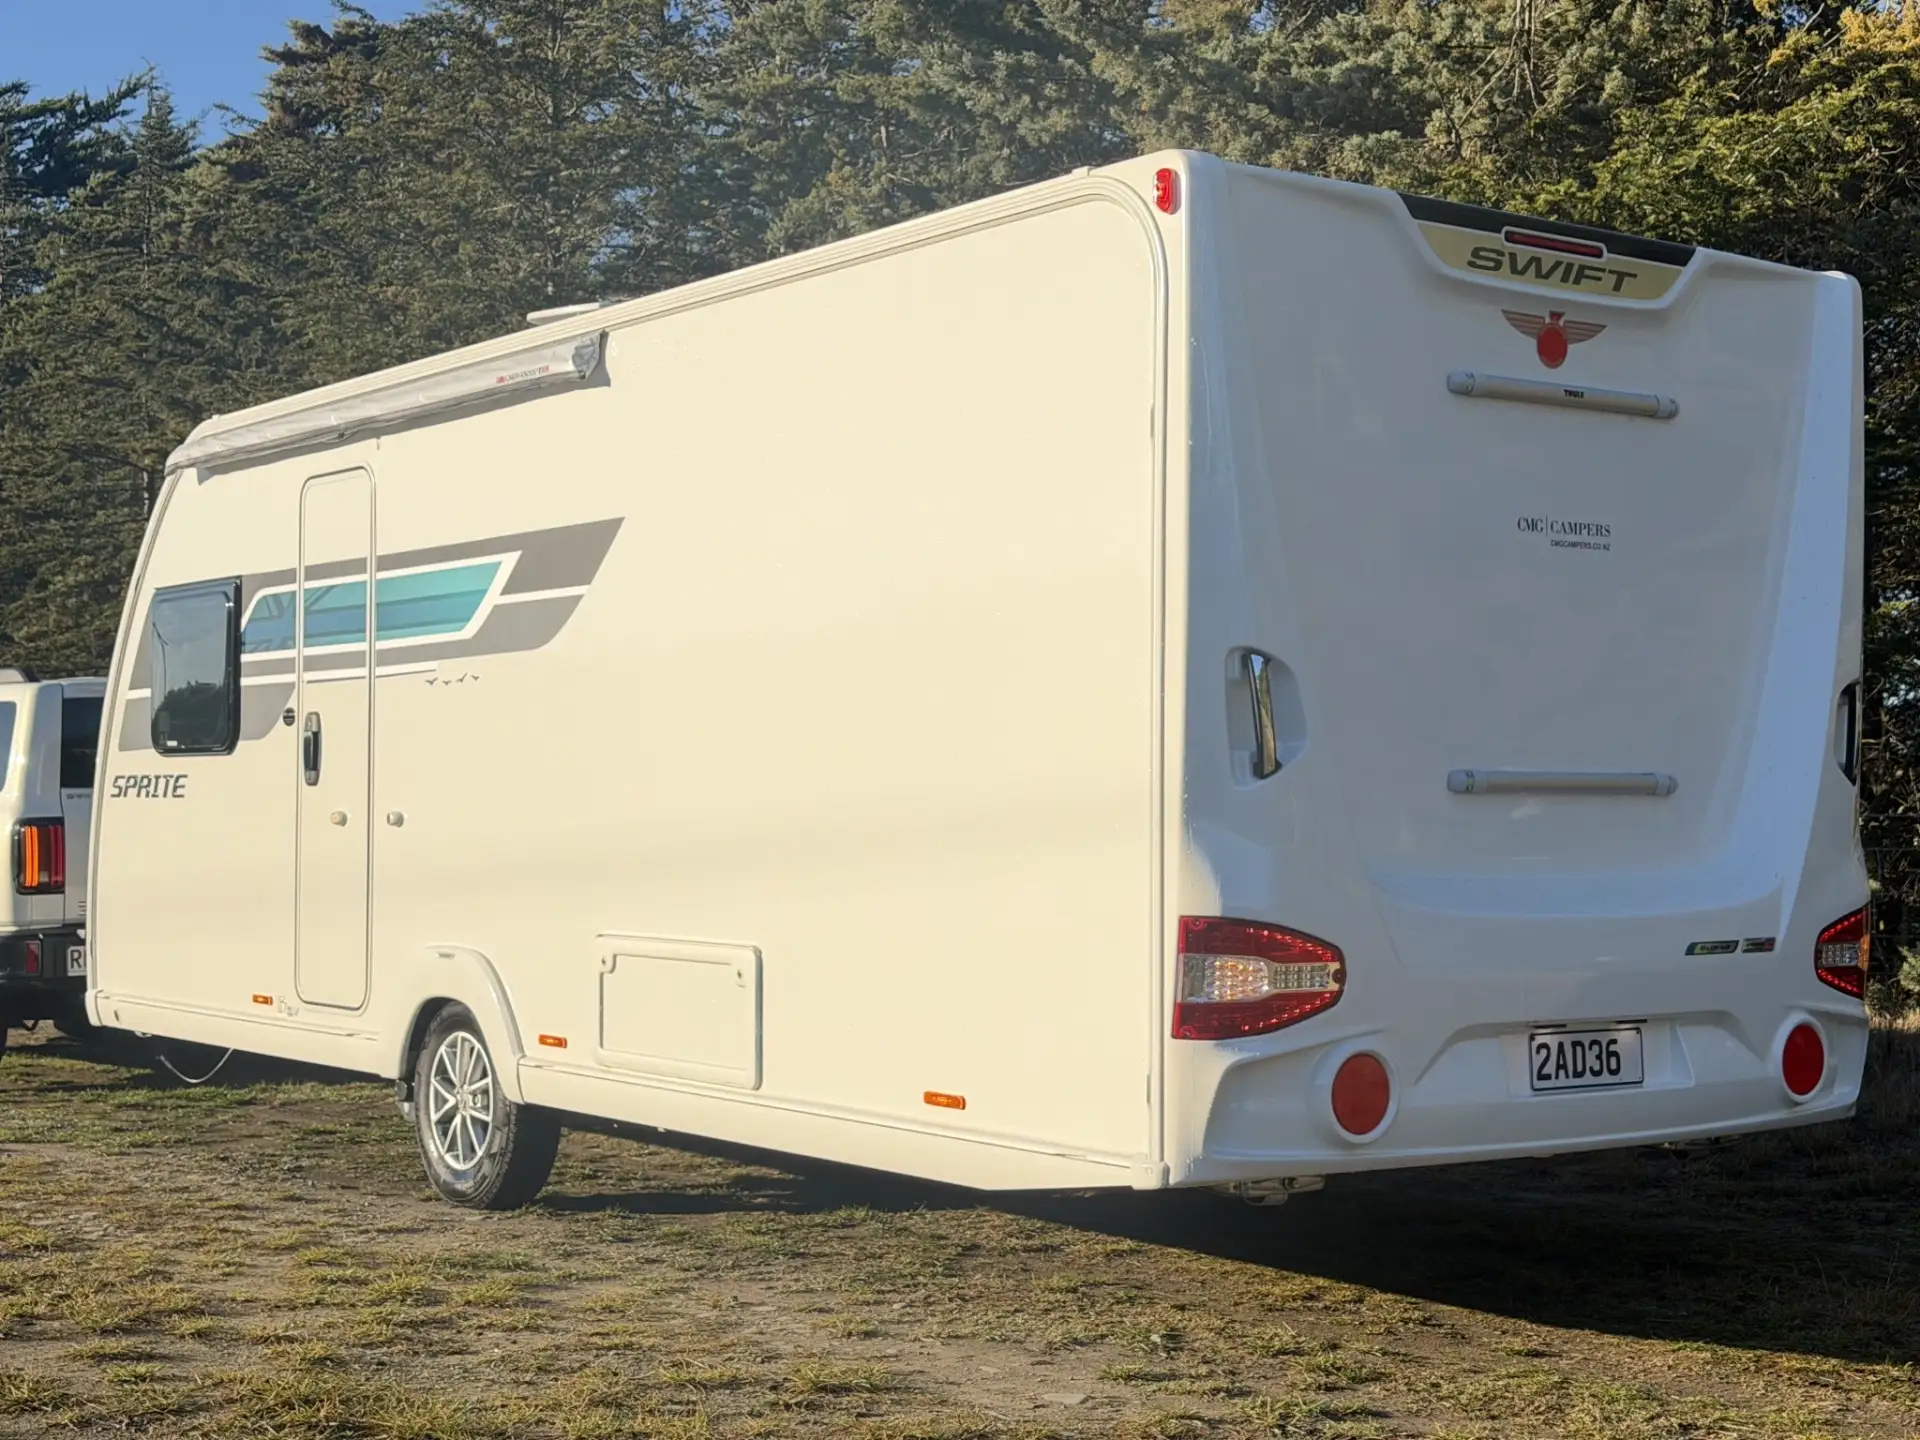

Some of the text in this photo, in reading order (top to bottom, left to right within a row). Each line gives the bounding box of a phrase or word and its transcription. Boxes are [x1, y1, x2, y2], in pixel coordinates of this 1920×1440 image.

[1467, 246, 1638, 292] SWIFT
[1517, 516, 1611, 538] CMG CAMPERS
[110, 774, 188, 798] SPRITE
[1536, 1037, 1621, 1081] 2AD36
